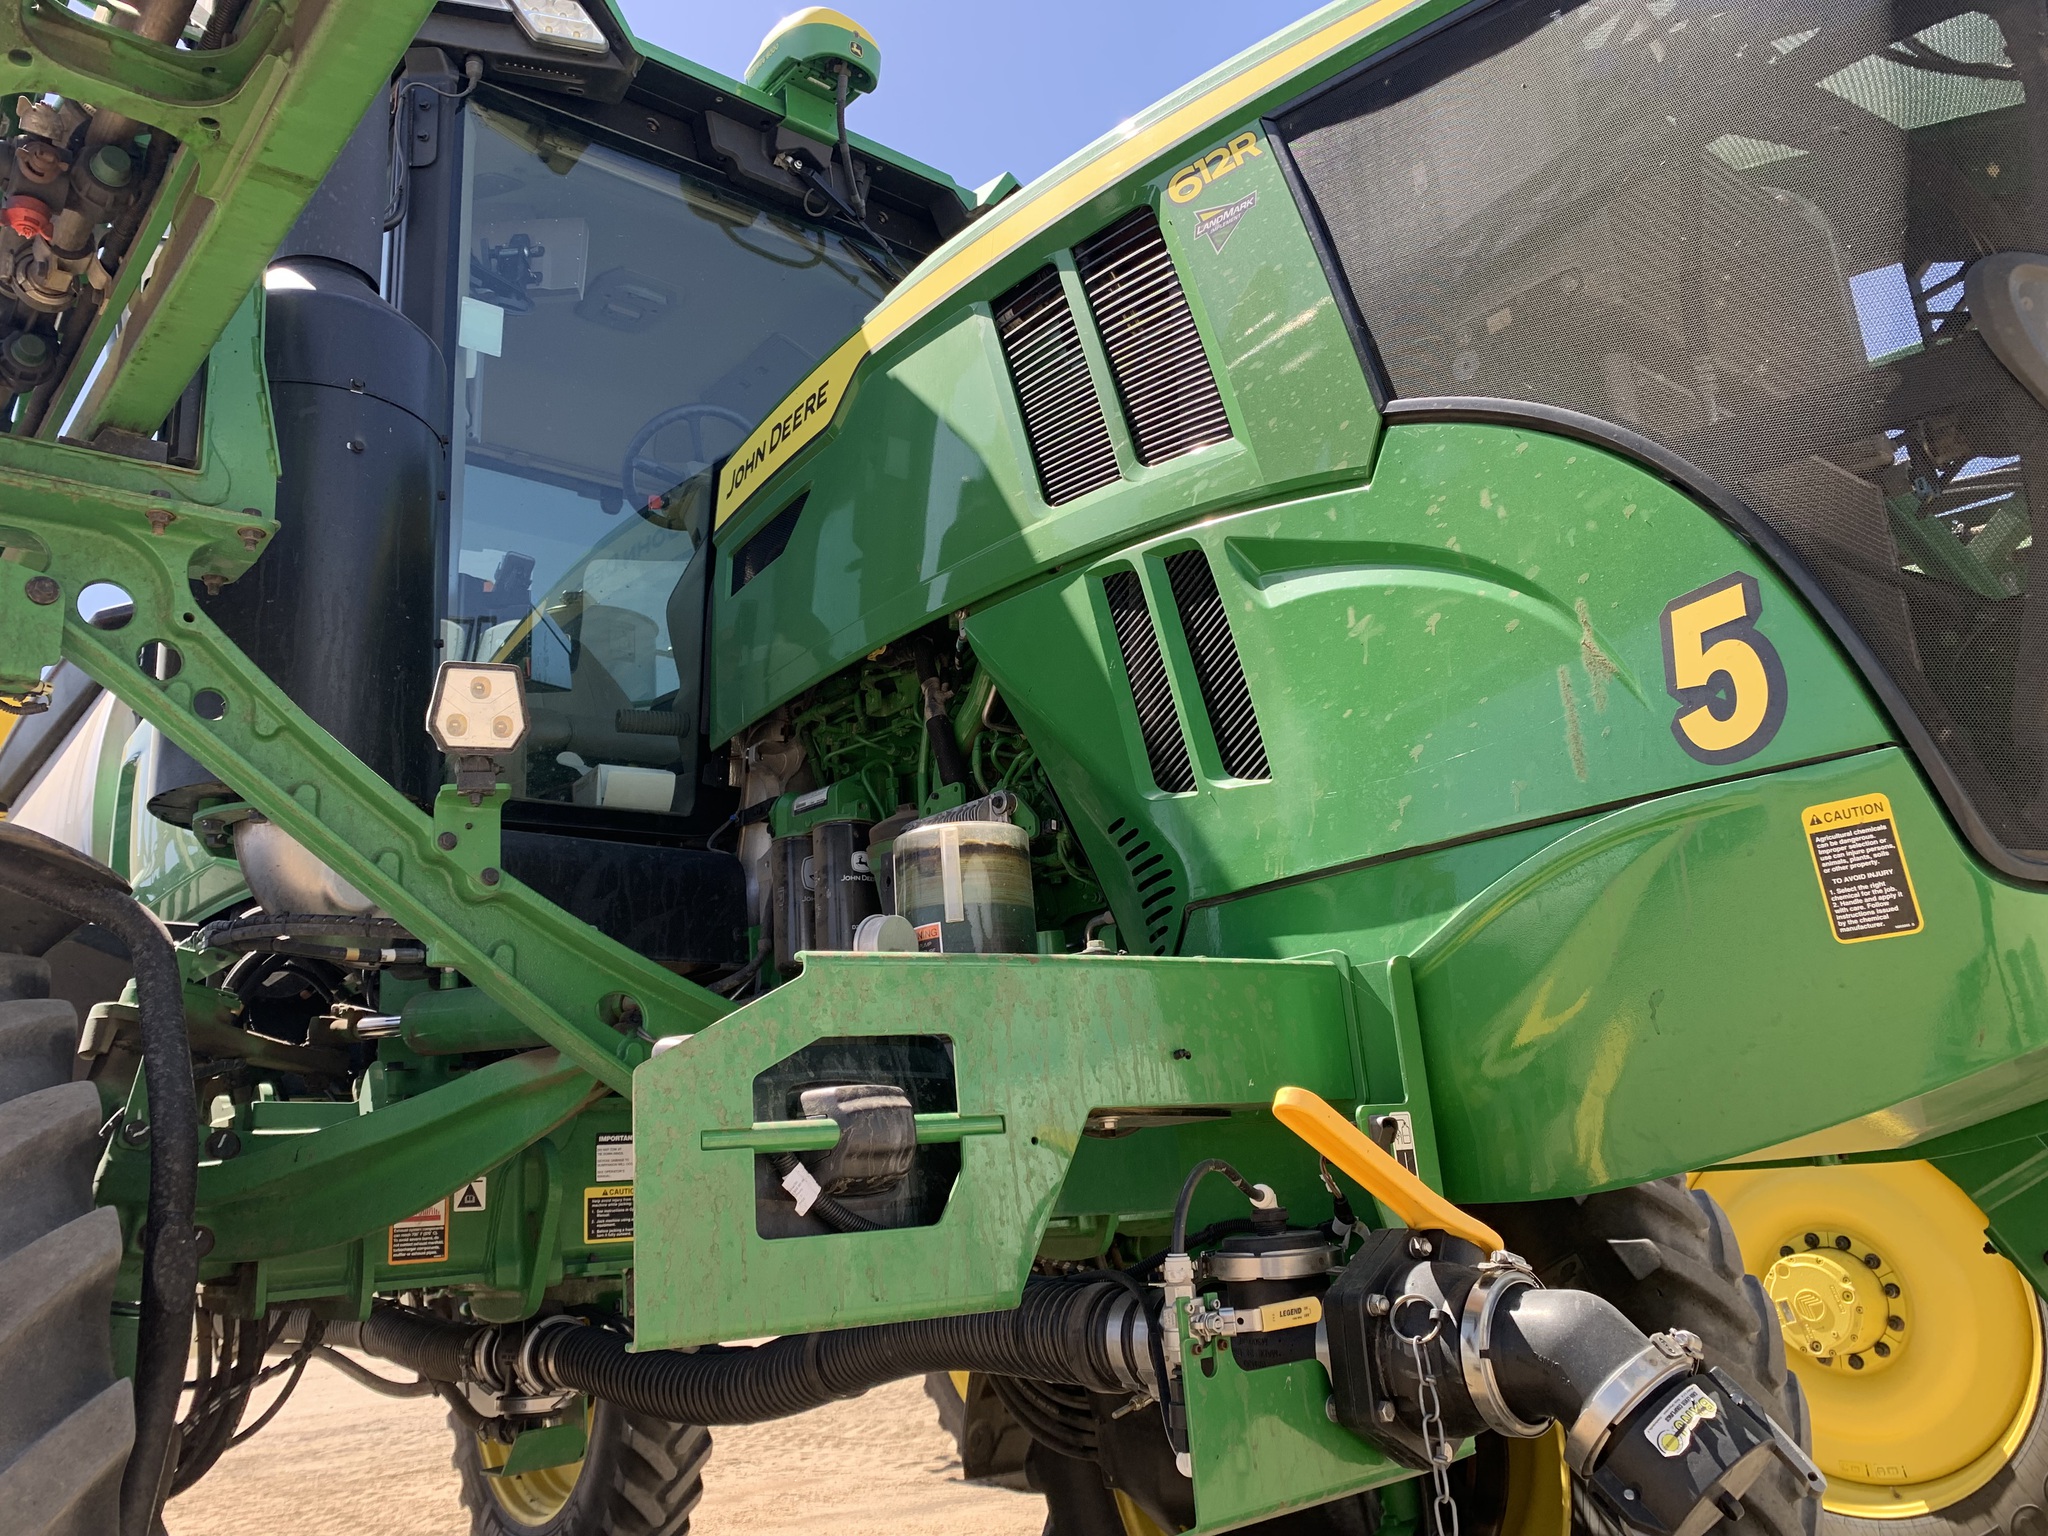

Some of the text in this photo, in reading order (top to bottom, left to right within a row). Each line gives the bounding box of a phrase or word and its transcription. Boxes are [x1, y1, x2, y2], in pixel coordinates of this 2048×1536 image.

[1168, 131, 1263, 204] 612R
[1196, 197, 1254, 235] LANDMARK
[726, 380, 830, 500] JOHN DEERE
[1666, 576, 1778, 758] 5
[1824, 802, 1884, 823] CAUTION
[1815, 824, 1888, 843] Agricultural chemicals
[1830, 839, 1838, 847] be
[1839, 834, 1877, 845] dangerous.
[1818, 845, 1848, 856] Improper
[1848, 840, 1879, 850] selection
[1846, 848, 1865, 858] injure
[1866, 843, 1896, 855] persons,
[1822, 850, 1890, 868] animals, plants, soils
[1832, 864, 1849, 872] other
[1850, 860, 1880, 870] property.
[841, 874, 861, 882] JOHN
[1844, 873, 1867, 883] AVOID
[1867, 869, 1894, 879] INJURY
[1831, 893, 1860, 902] chemical
[1872, 888, 1884, 896] the
[1884, 886, 1898, 894] job.
[1836, 885, 1857, 895] Select
[1858, 883, 1869, 891] the
[1870, 881, 1886, 890] right
[1840, 898, 1863, 907] Handle
[1878, 894, 1897, 902] apply
[1867, 901, 1890, 909] Follow
[1836, 906, 1900, 920] instructions issued
[1859, 914, 1890, 923] chemical
[1840, 922, 1886, 933] manufacturer.
[1280, 1308, 1302, 1318] LEGEND
